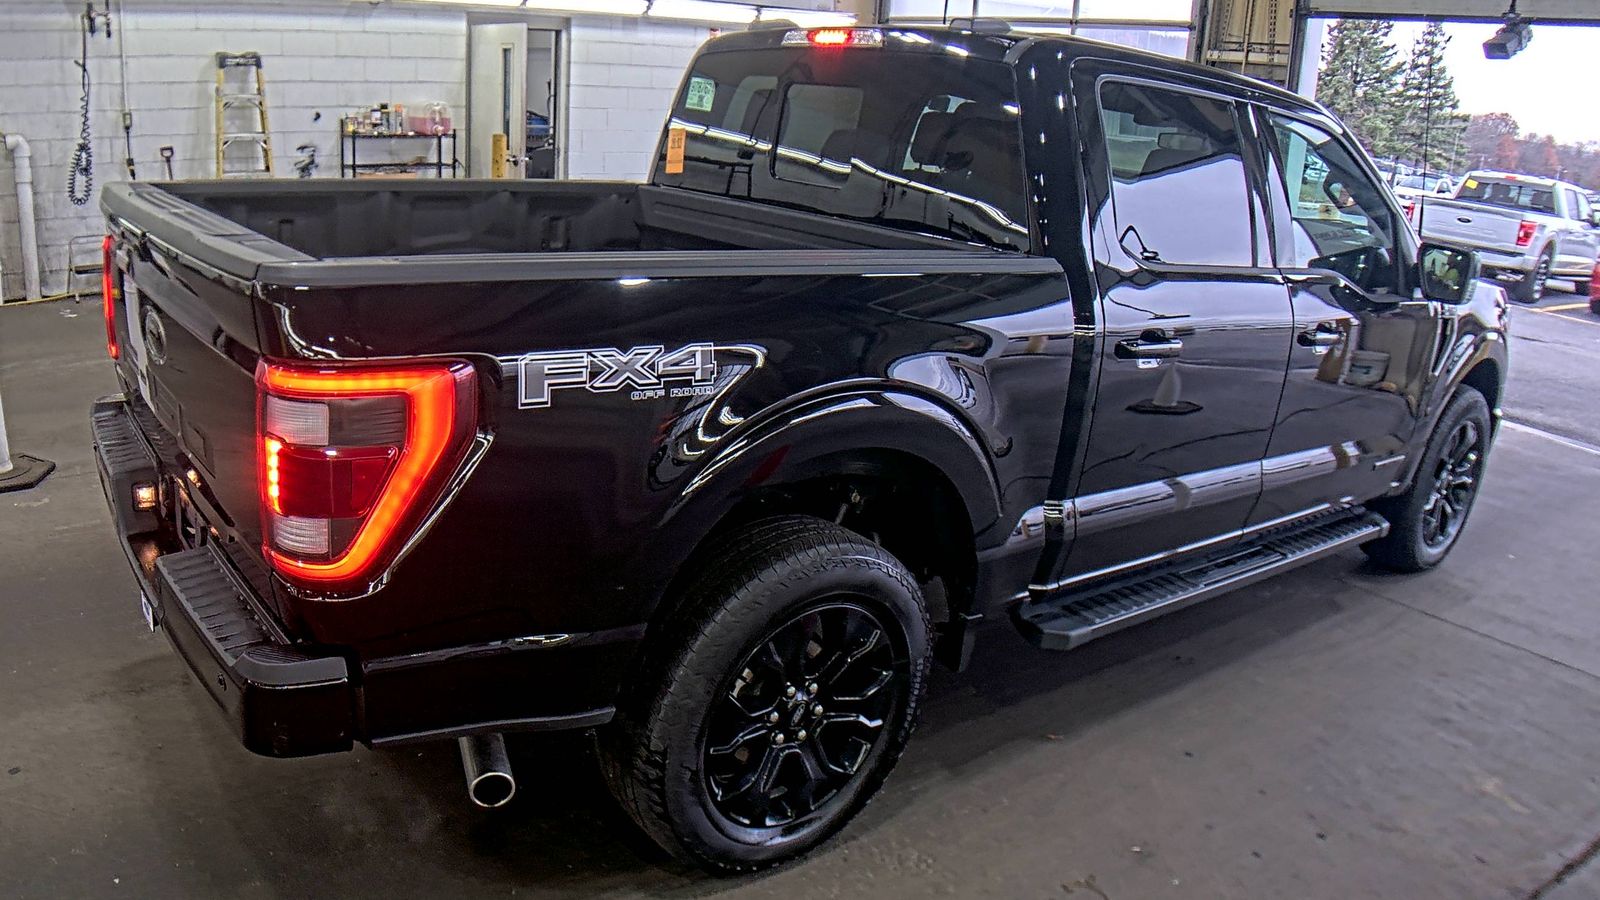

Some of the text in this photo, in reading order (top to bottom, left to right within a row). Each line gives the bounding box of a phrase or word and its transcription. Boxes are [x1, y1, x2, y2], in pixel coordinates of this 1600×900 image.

[518, 343, 717, 409] FX4
[630, 386, 714, 400] OFF ROAD
